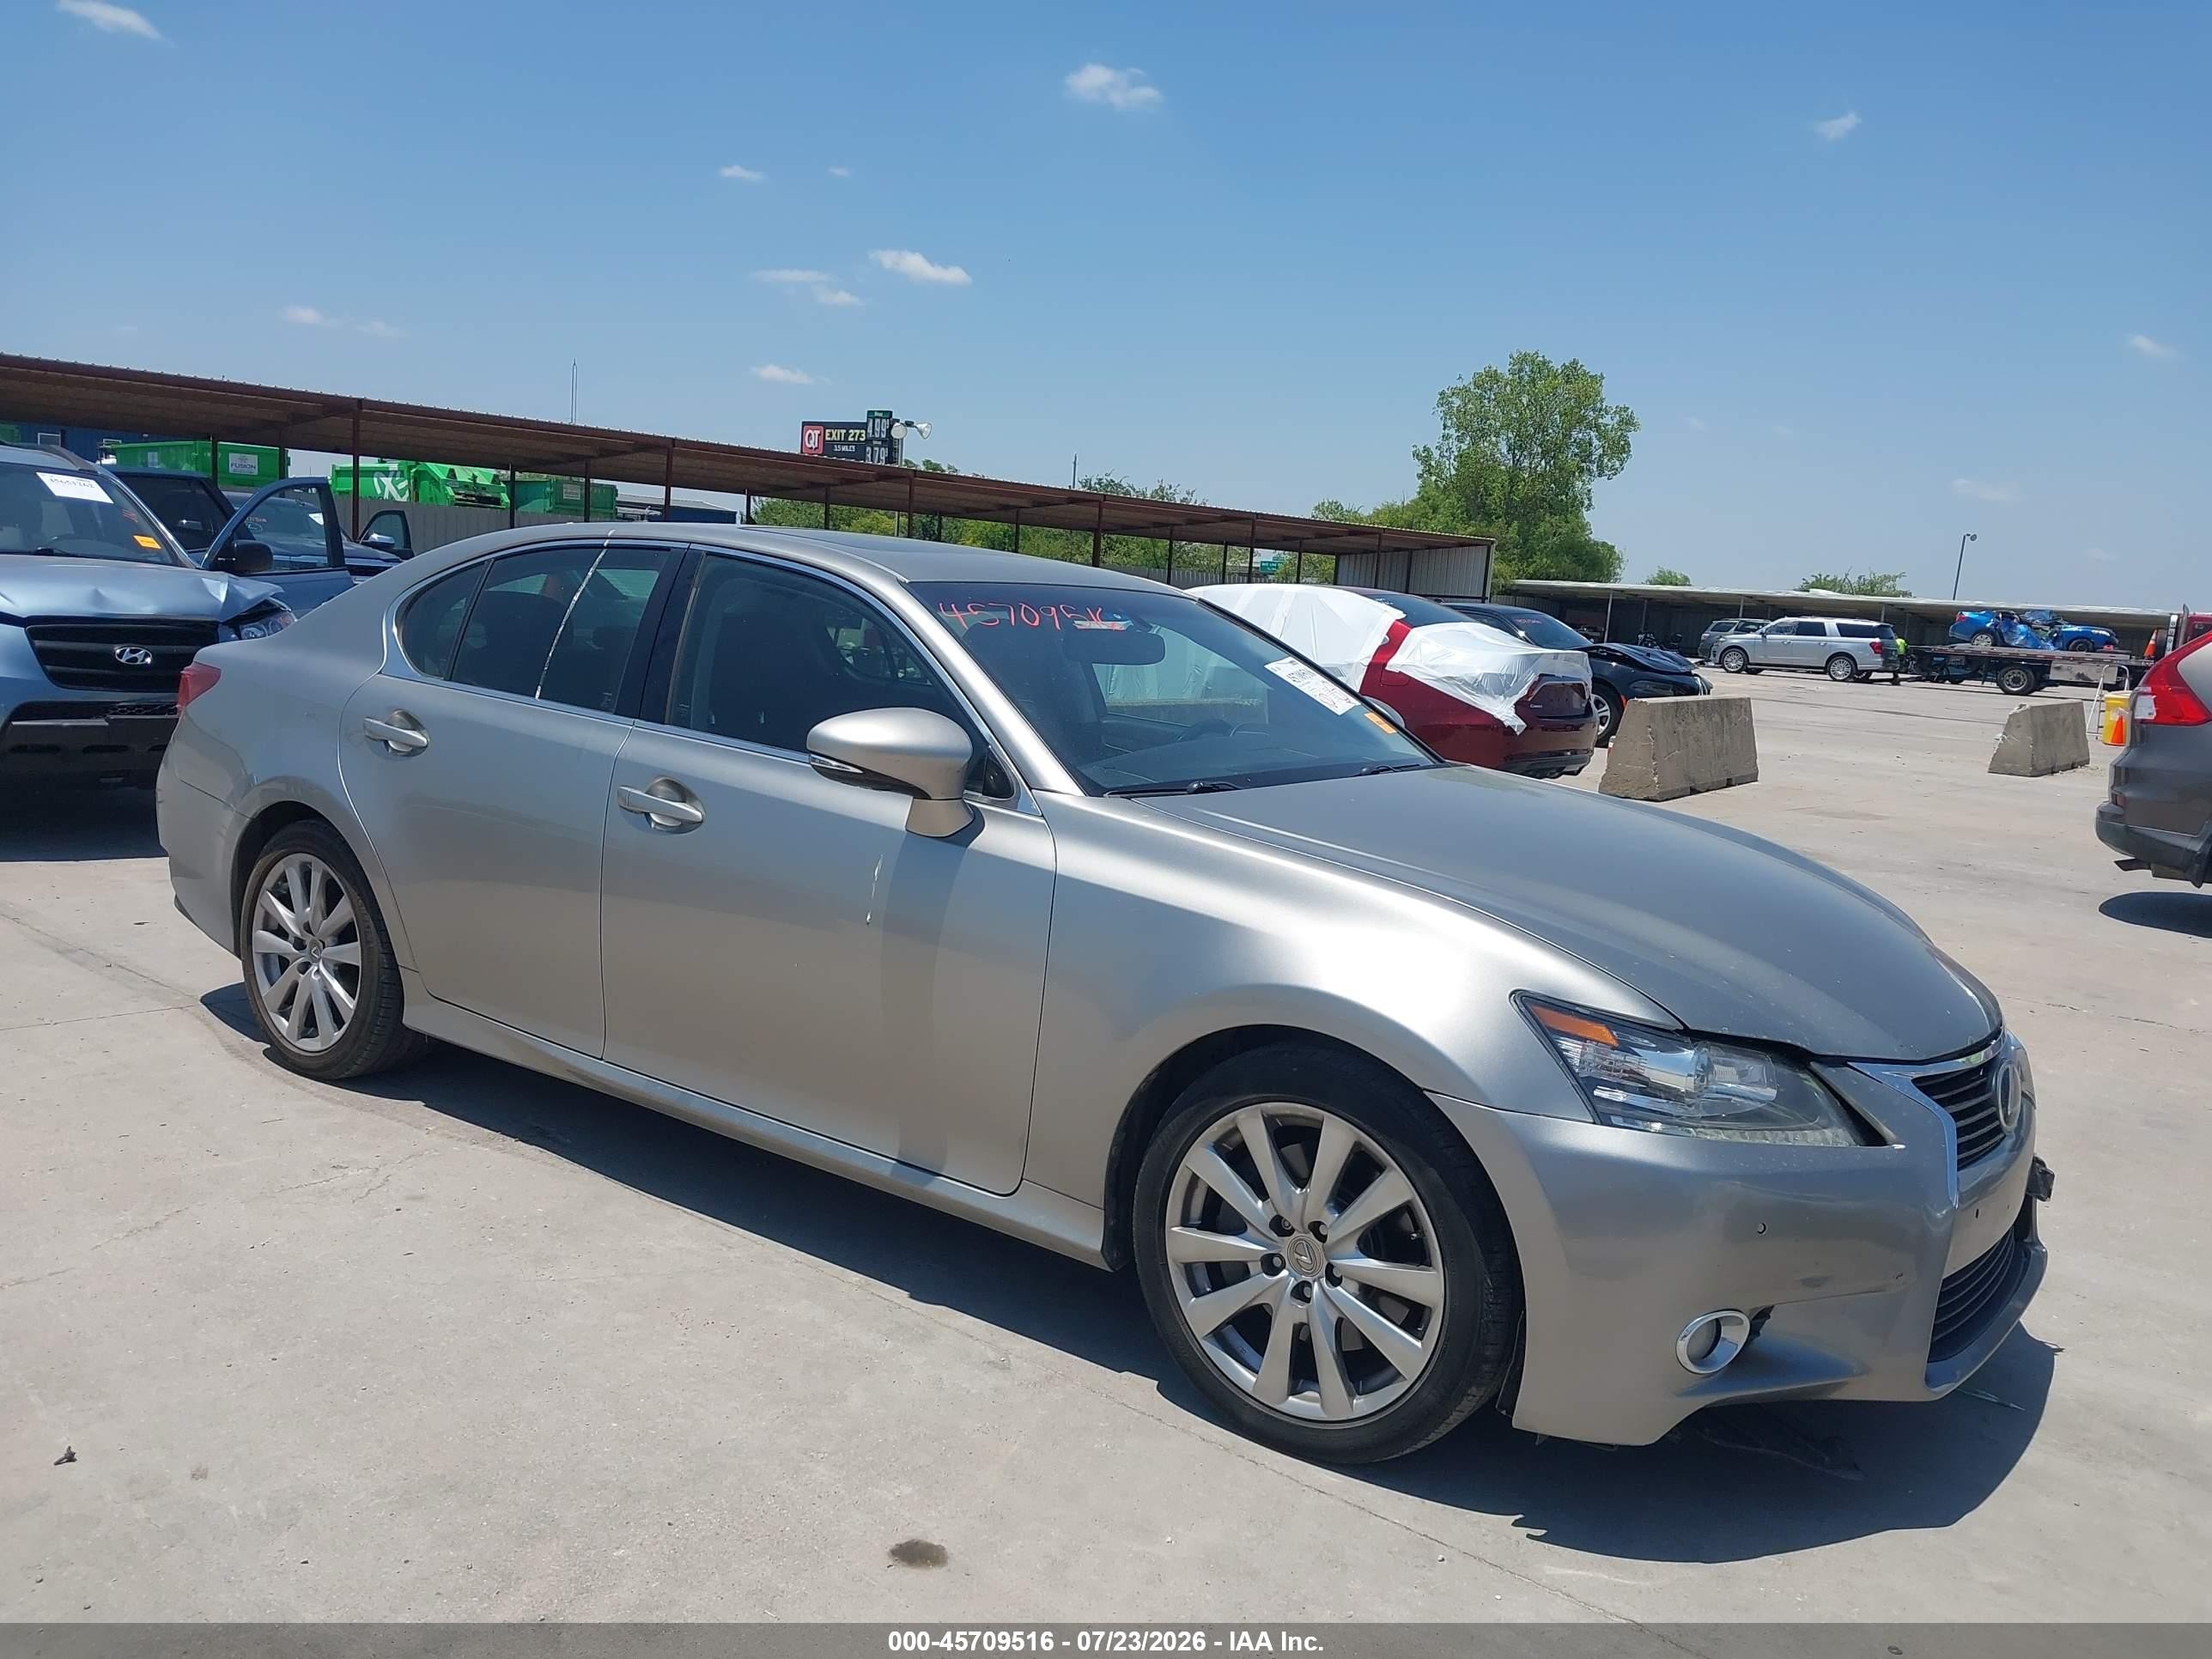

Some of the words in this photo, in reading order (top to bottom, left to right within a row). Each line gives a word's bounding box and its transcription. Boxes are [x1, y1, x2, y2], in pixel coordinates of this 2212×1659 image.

[805, 430, 822, 449] QT
[825, 429, 847, 441] EXIT
[848, 429, 866, 441] 273
